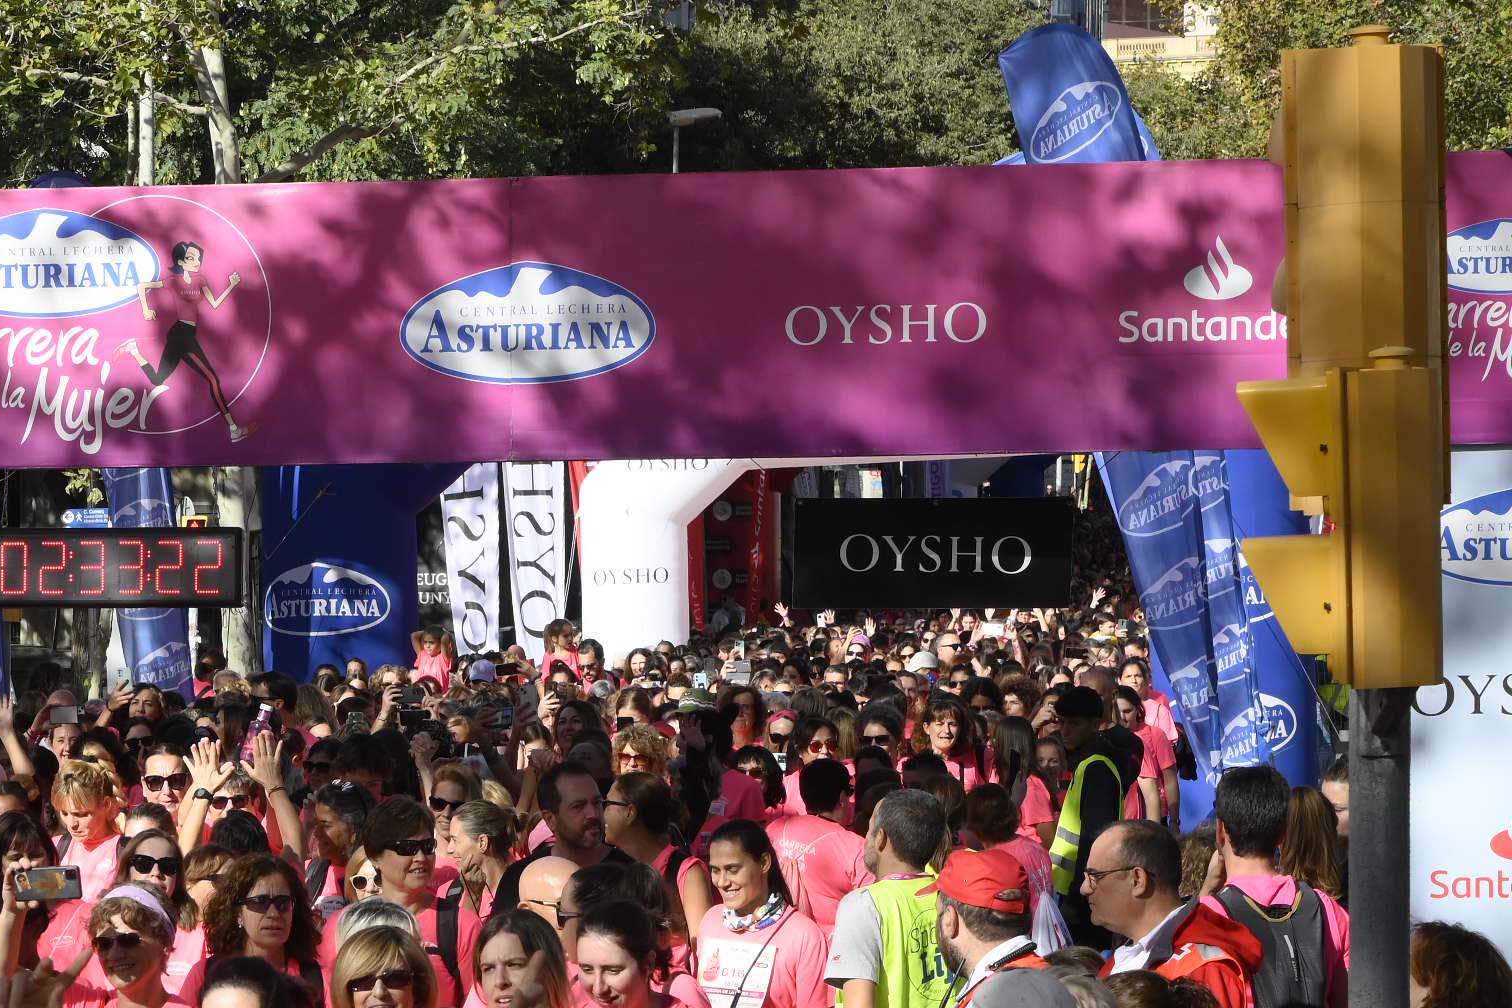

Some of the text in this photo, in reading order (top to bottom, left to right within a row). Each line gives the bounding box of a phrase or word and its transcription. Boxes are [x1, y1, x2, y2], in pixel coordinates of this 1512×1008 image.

[63, 245, 136, 257] LECHERA
[459, 302, 628, 318] CENTRAL LECHERA
[785, 302, 988, 347] OYSHO
[1447, 300, 1512, 330] arre
[420, 308, 636, 354] ASTURIANA
[1467, 329, 1487, 357] la
[0, 367, 27, 409] la
[20, 360, 170, 455] Mujer
[0, 540, 223, 595] 02:33:22
[839, 533, 1032, 575] OYSHO
[592, 566, 670, 586] OYSHO
[269, 591, 381, 620] ASTURIANA
[281, 587, 377, 597] CENTRAL LECHERA
